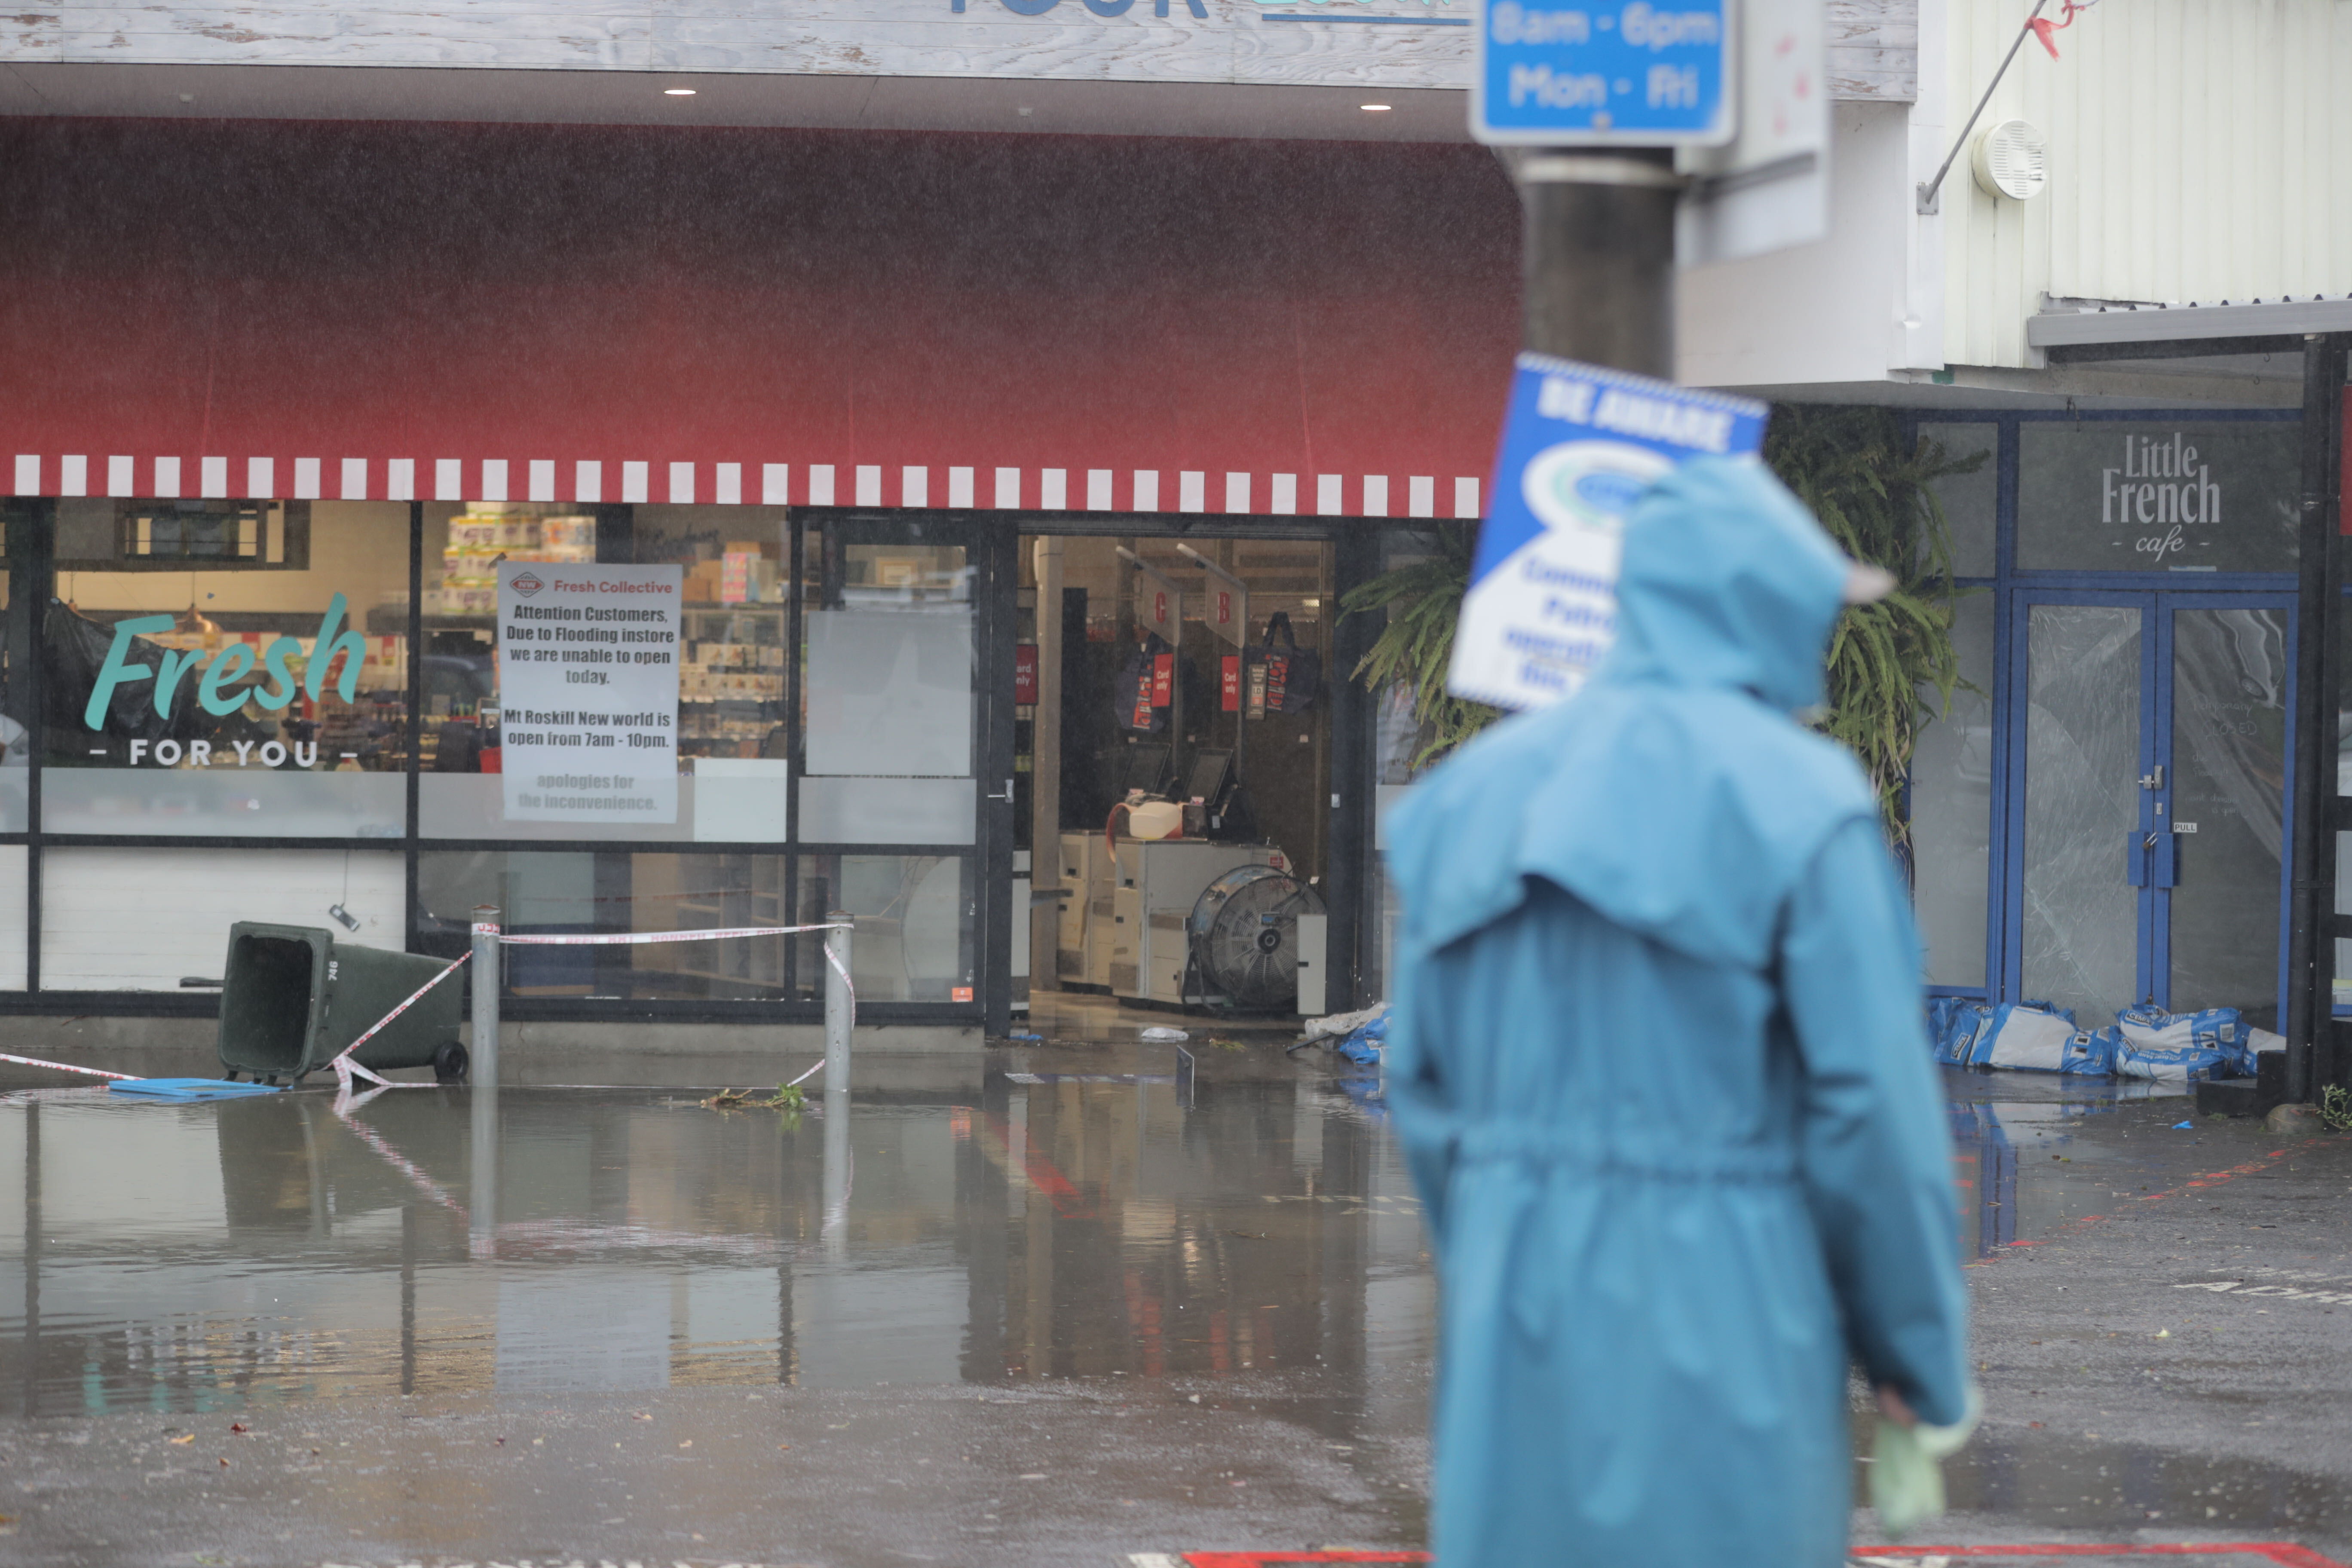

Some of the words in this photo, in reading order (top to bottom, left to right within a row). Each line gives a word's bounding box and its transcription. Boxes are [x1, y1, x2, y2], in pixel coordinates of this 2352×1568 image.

[1508, 62, 1607, 108] Mon
[1645, 63, 1698, 108] Fri
[2125, 432, 2198, 478] Little
[2102, 464, 2220, 524] French
[2135, 524, 2185, 562] cafe
[554, 580, 595, 593] Fresh
[599, 581, 673, 594] Collective
[514, 605, 581, 621] Attention
[585, 607, 668, 623] Customers,
[1218, 592, 1230, 623] B
[507, 625, 534, 640] Due
[538, 628, 551, 640] to
[556, 627, 618, 644] Flooding
[622, 629, 674, 643] instore
[84, 592, 367, 731] Fresh
[510, 649, 530, 661] we
[534, 650, 557, 662] are
[563, 649, 612, 663] unable
[616, 650, 630, 663] to
[634, 652, 670, 665] open
[1017, 664, 1031, 673] ard
[1157, 670, 1169, 679] Card
[566, 670, 610, 685] today.
[1016, 676, 1030, 686] nly
[1157, 680, 1168, 691] only
[1225, 673, 1236, 682] Card
[1225, 685, 1235, 695] only
[504, 709, 522, 724] Mt
[525, 710, 574, 725] Roskill
[579, 711, 609, 726] New
[613, 712, 653, 726] world
[657, 713, 670, 726] is
[508, 732, 543, 746] open
[548, 732, 581, 746] from
[585, 733, 614, 747] 7am
[626, 733, 669, 749] 10pm.
[130, 739, 211, 766] FOR
[232, 740, 318, 767] YOU
[537, 774, 610, 790] apologies
[614, 775, 634, 789] for
[518, 793, 540, 808] the
[545, 794, 658, 810] inconvenience.
[328, 961, 338, 981] 746
